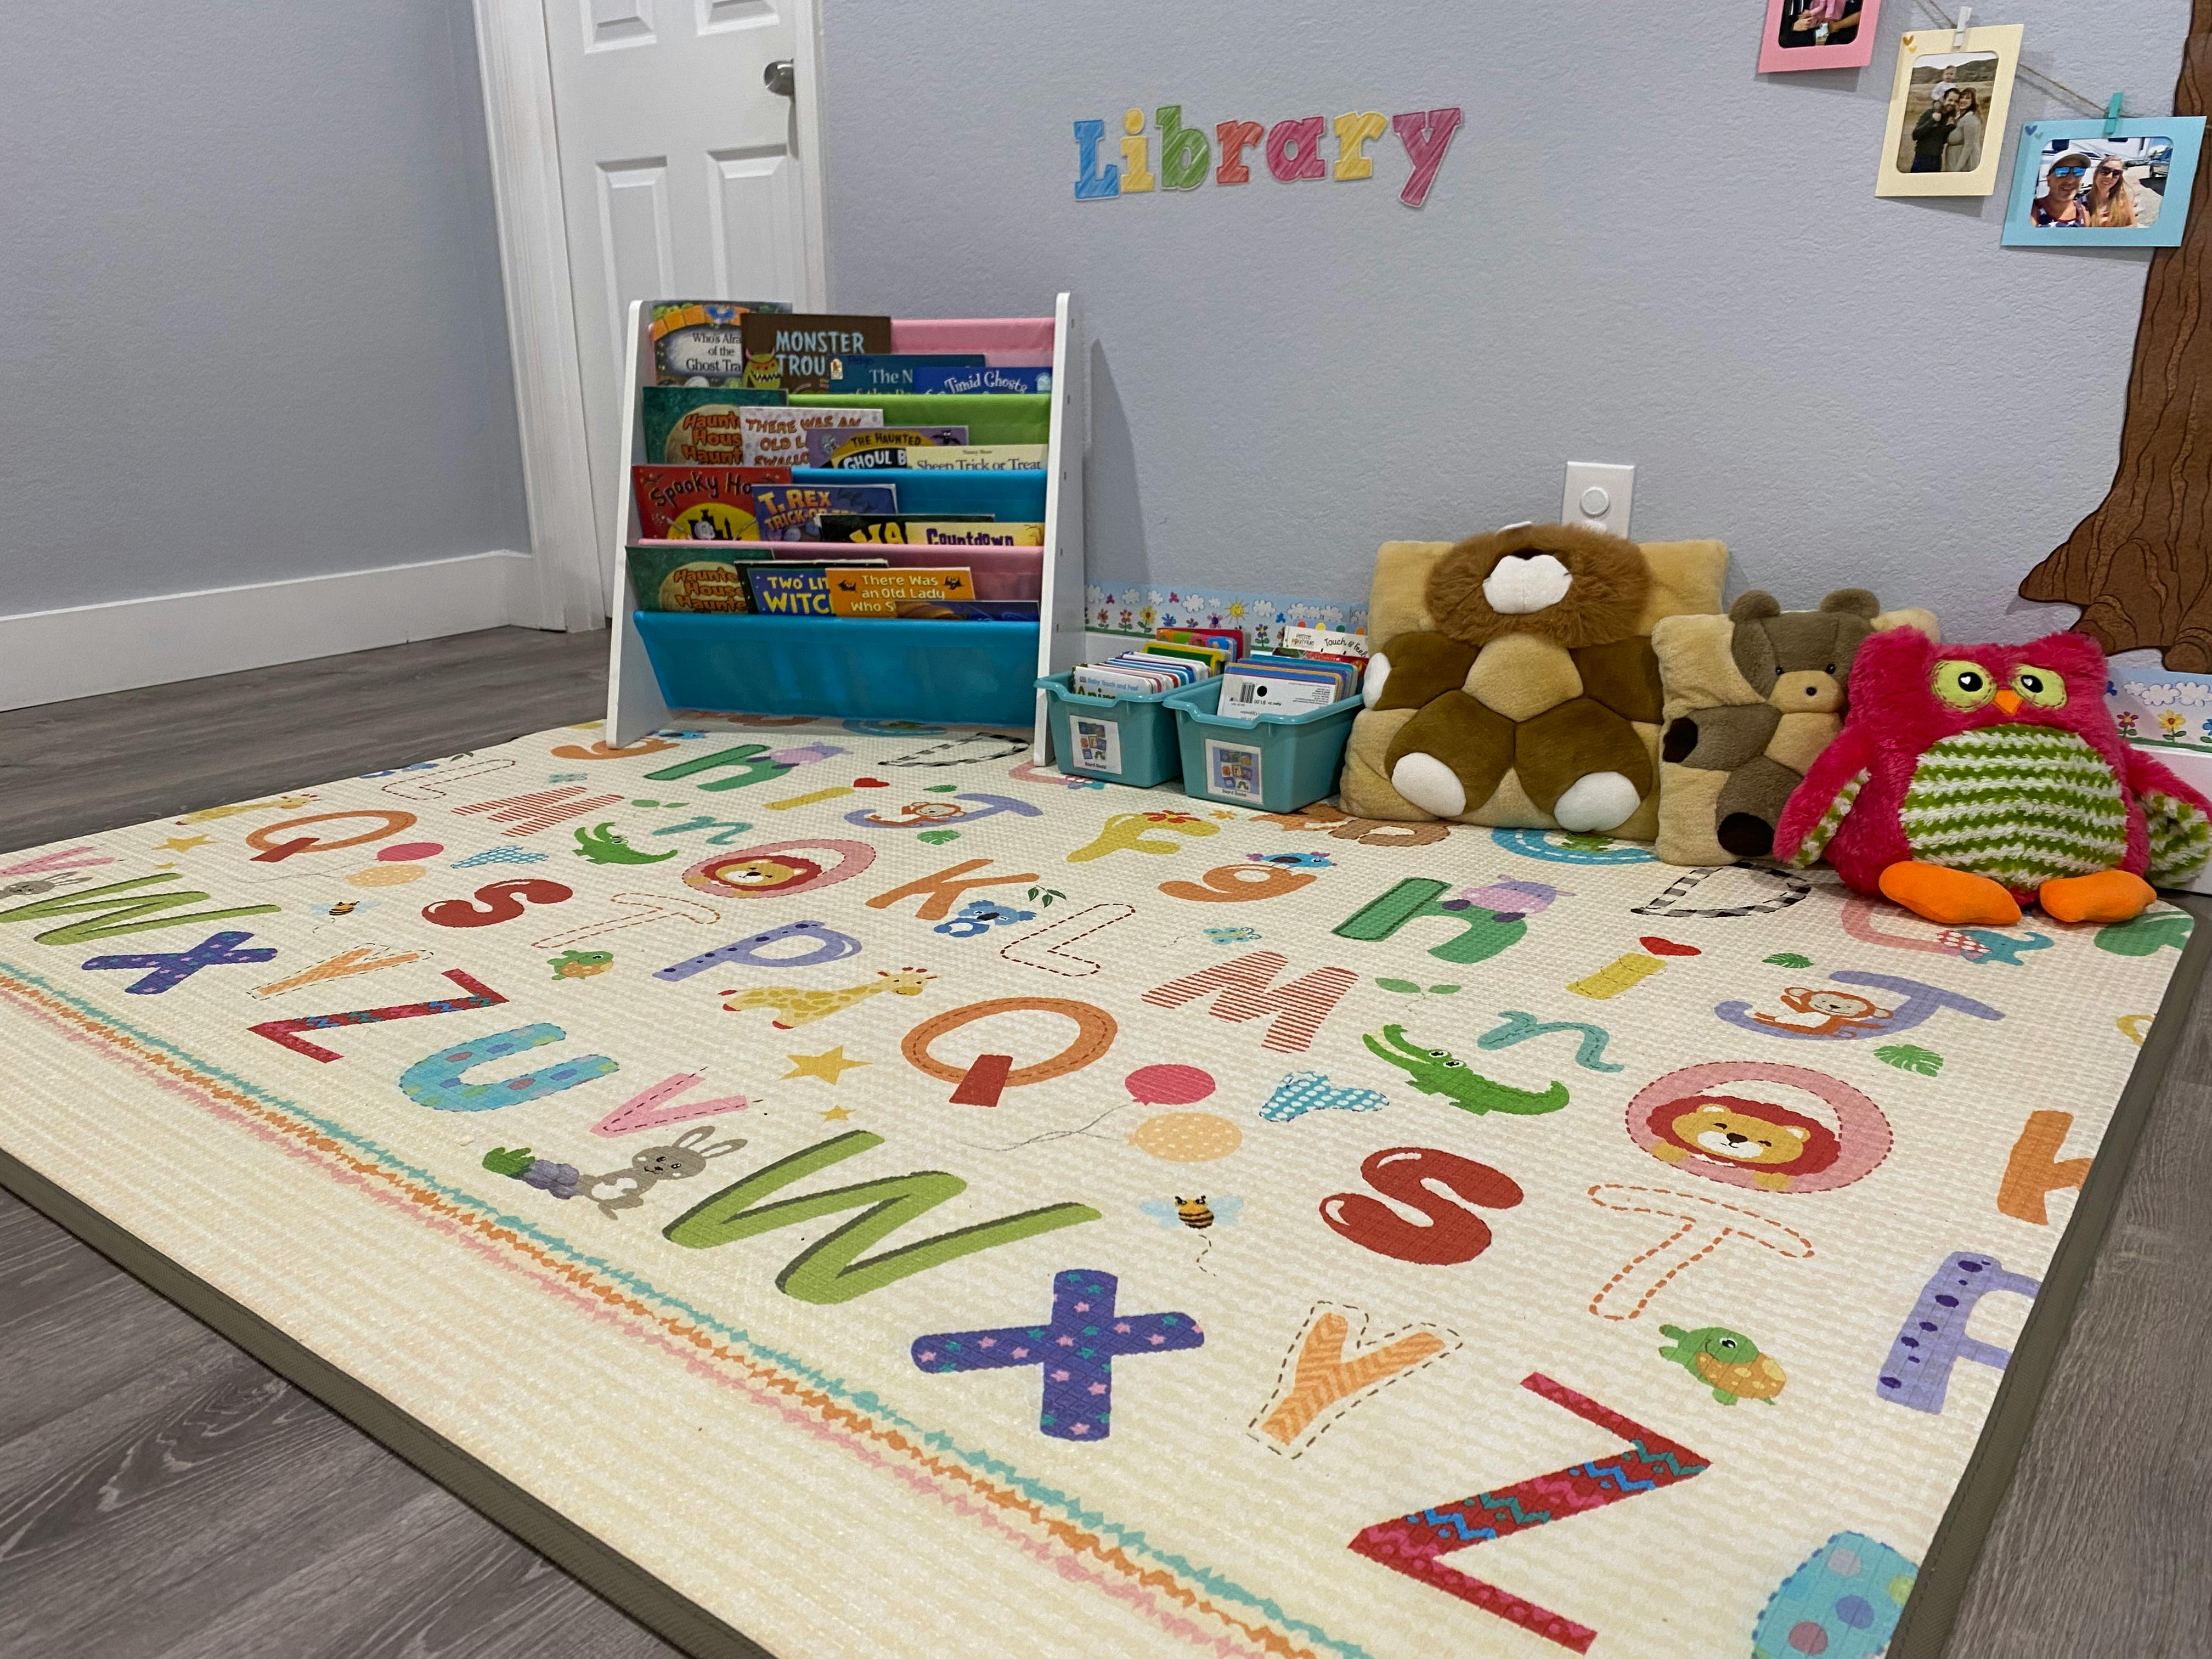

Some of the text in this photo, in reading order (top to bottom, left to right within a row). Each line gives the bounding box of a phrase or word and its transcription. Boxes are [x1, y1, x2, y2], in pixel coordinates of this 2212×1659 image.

[1073, 105, 1462, 208] Library
[692, 332, 720, 343] Who's
[776, 330, 865, 354] MONSTER
[708, 346, 735, 356] of the
[686, 359, 719, 372] Ghost
[776, 355, 825, 376] TROU
[870, 369, 899, 383] The
[944, 370, 1028, 394] Timid Ghosts
[746, 415, 861, 433] THERE WAS AN
[692, 428, 742, 445] Hous
[760, 436, 808, 451] OLD L
[851, 433, 921, 448] THE HAUNTED
[681, 444, 743, 465] Haunt
[843, 450, 891, 469] GHOUL
[917, 459, 1041, 470] Sheep Trick or Treat
[649, 471, 752, 508] Spooky Ho
[926, 528, 1014, 546] Countdown
[768, 577, 803, 589] TWO
[862, 575, 938, 586] There Was
[763, 591, 835, 614] WITC
[851, 601, 896, 612] Who S
[862, 589, 945, 600] an Old Lady
[1324, 637, 1346, 646] Touch
[1353, 643, 1368, 657] Feel
[450, 786, 624, 837] M
[246, 810, 417, 862] Q
[865, 859, 1040, 921] K
[421, 878, 573, 927] S
[652, 920, 862, 981] P
[1001, 904, 1136, 977] L
[82, 931, 278, 994] X
[1141, 951, 1359, 1053] M
[246, 968, 510, 1063] Z
[901, 997, 1118, 1107] Q
[399, 1023, 619, 1111] U
[590, 1071, 749, 1137] V
[662, 1130, 1102, 1305] W
[1319, 1147, 1523, 1266] S
[1588, 1184, 1815, 1319] T
[911, 1268, 1205, 1442] X
[1247, 1301, 1463, 1459] Y
[1347, 1372, 1713, 1656] Z
